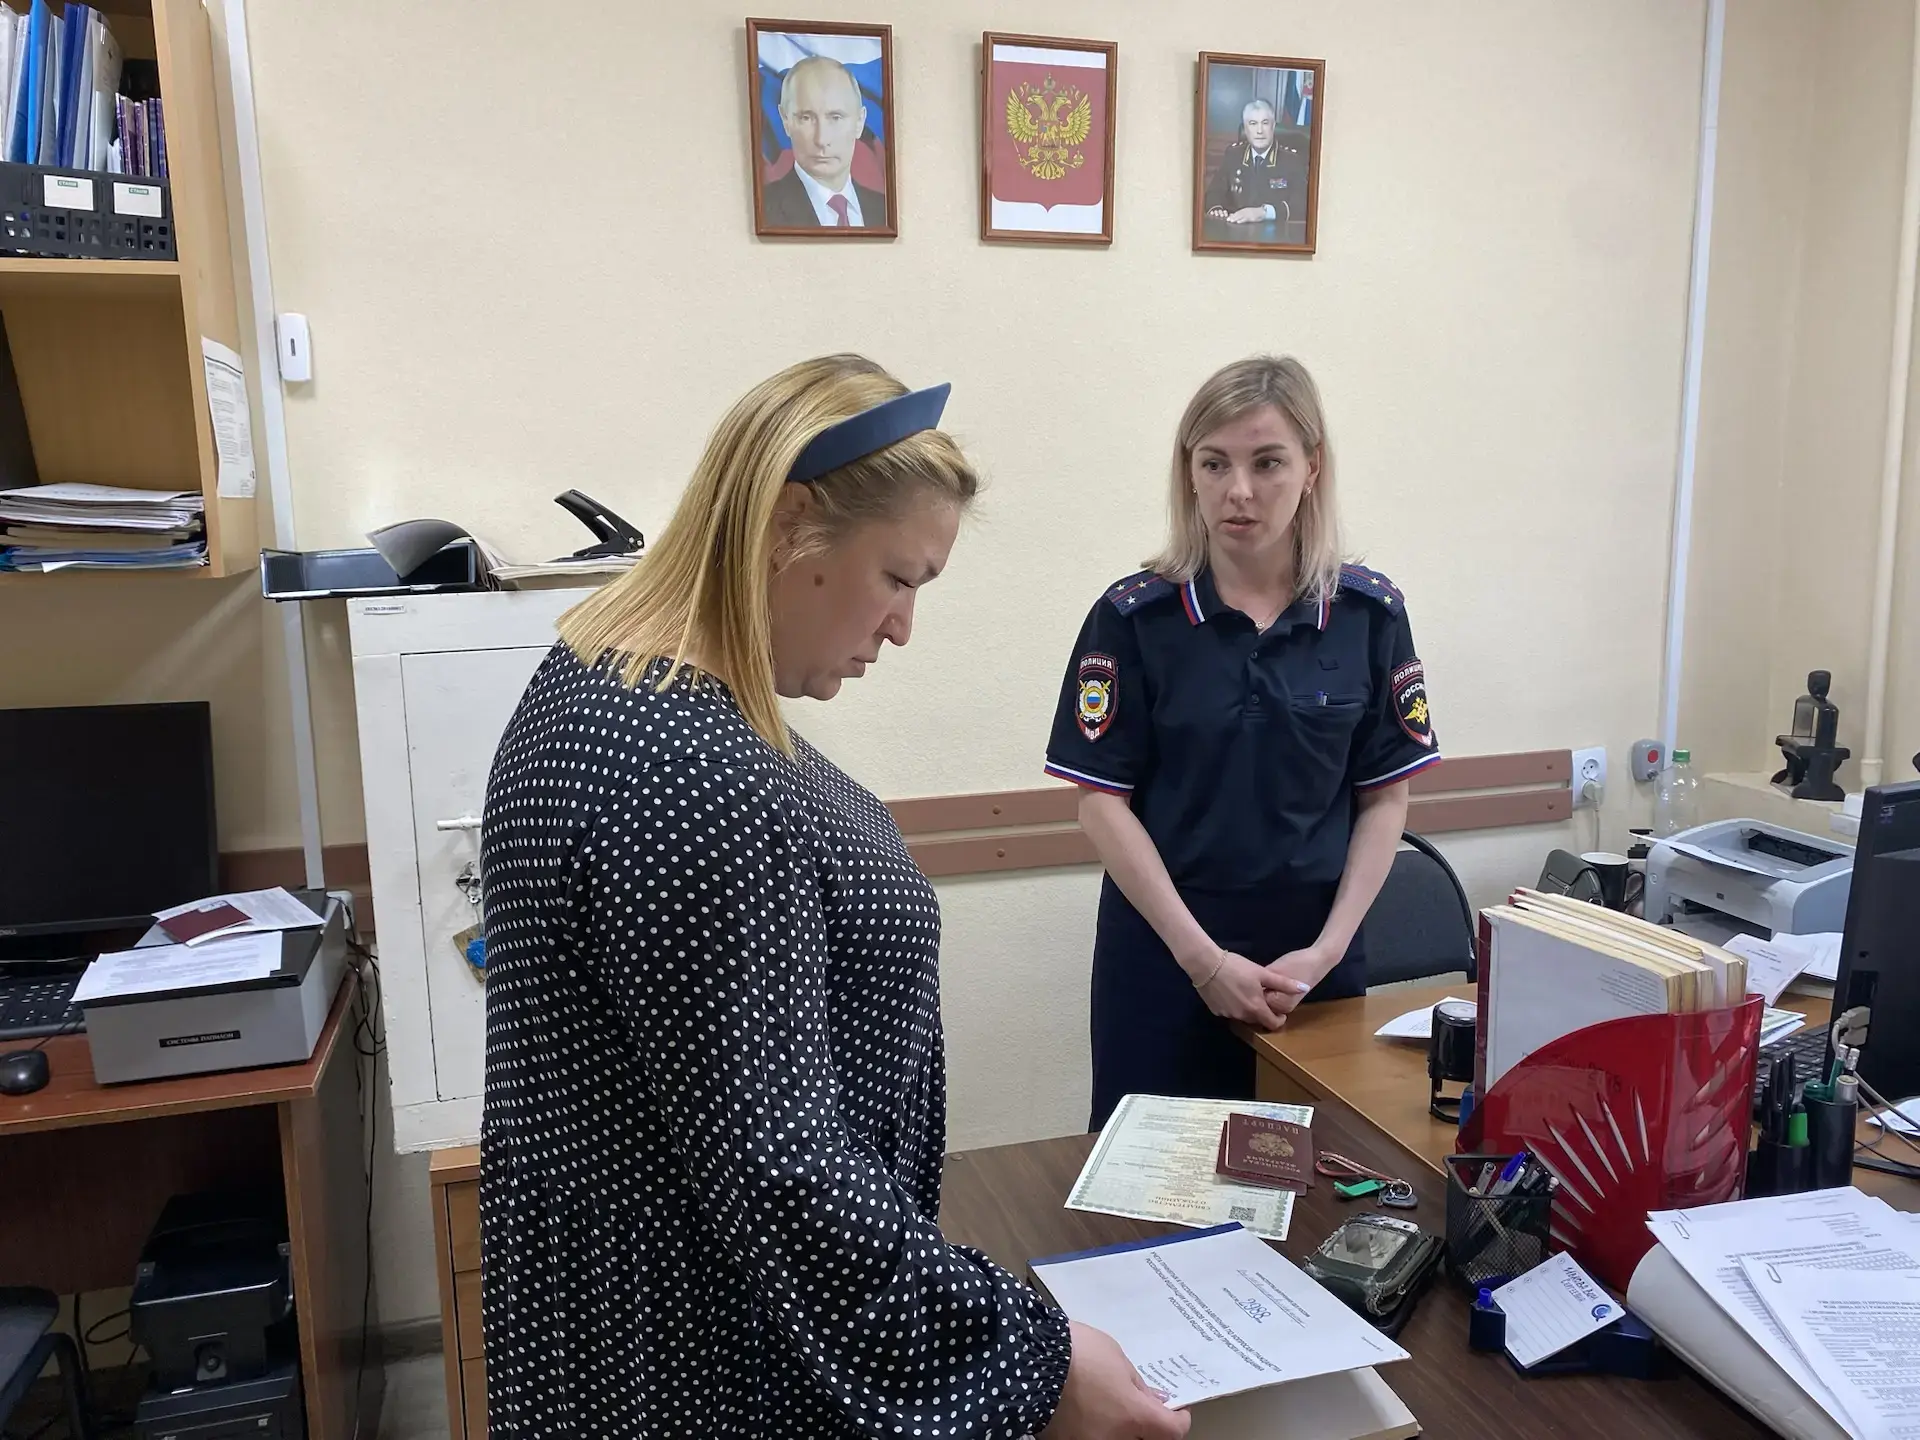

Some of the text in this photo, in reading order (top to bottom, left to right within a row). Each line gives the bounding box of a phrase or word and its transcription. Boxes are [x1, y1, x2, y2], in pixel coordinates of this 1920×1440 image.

[1081, 657, 1112, 669] ПОЛИЦИЯ
[1085, 727, 1100, 740] МВД
[1241, 1118, 1298, 1135] ПАСПОРТ
[1242, 1158, 1300, 1173] РОССИЙСКАЯ
[1238, 1298, 1272, 1320] 2988
